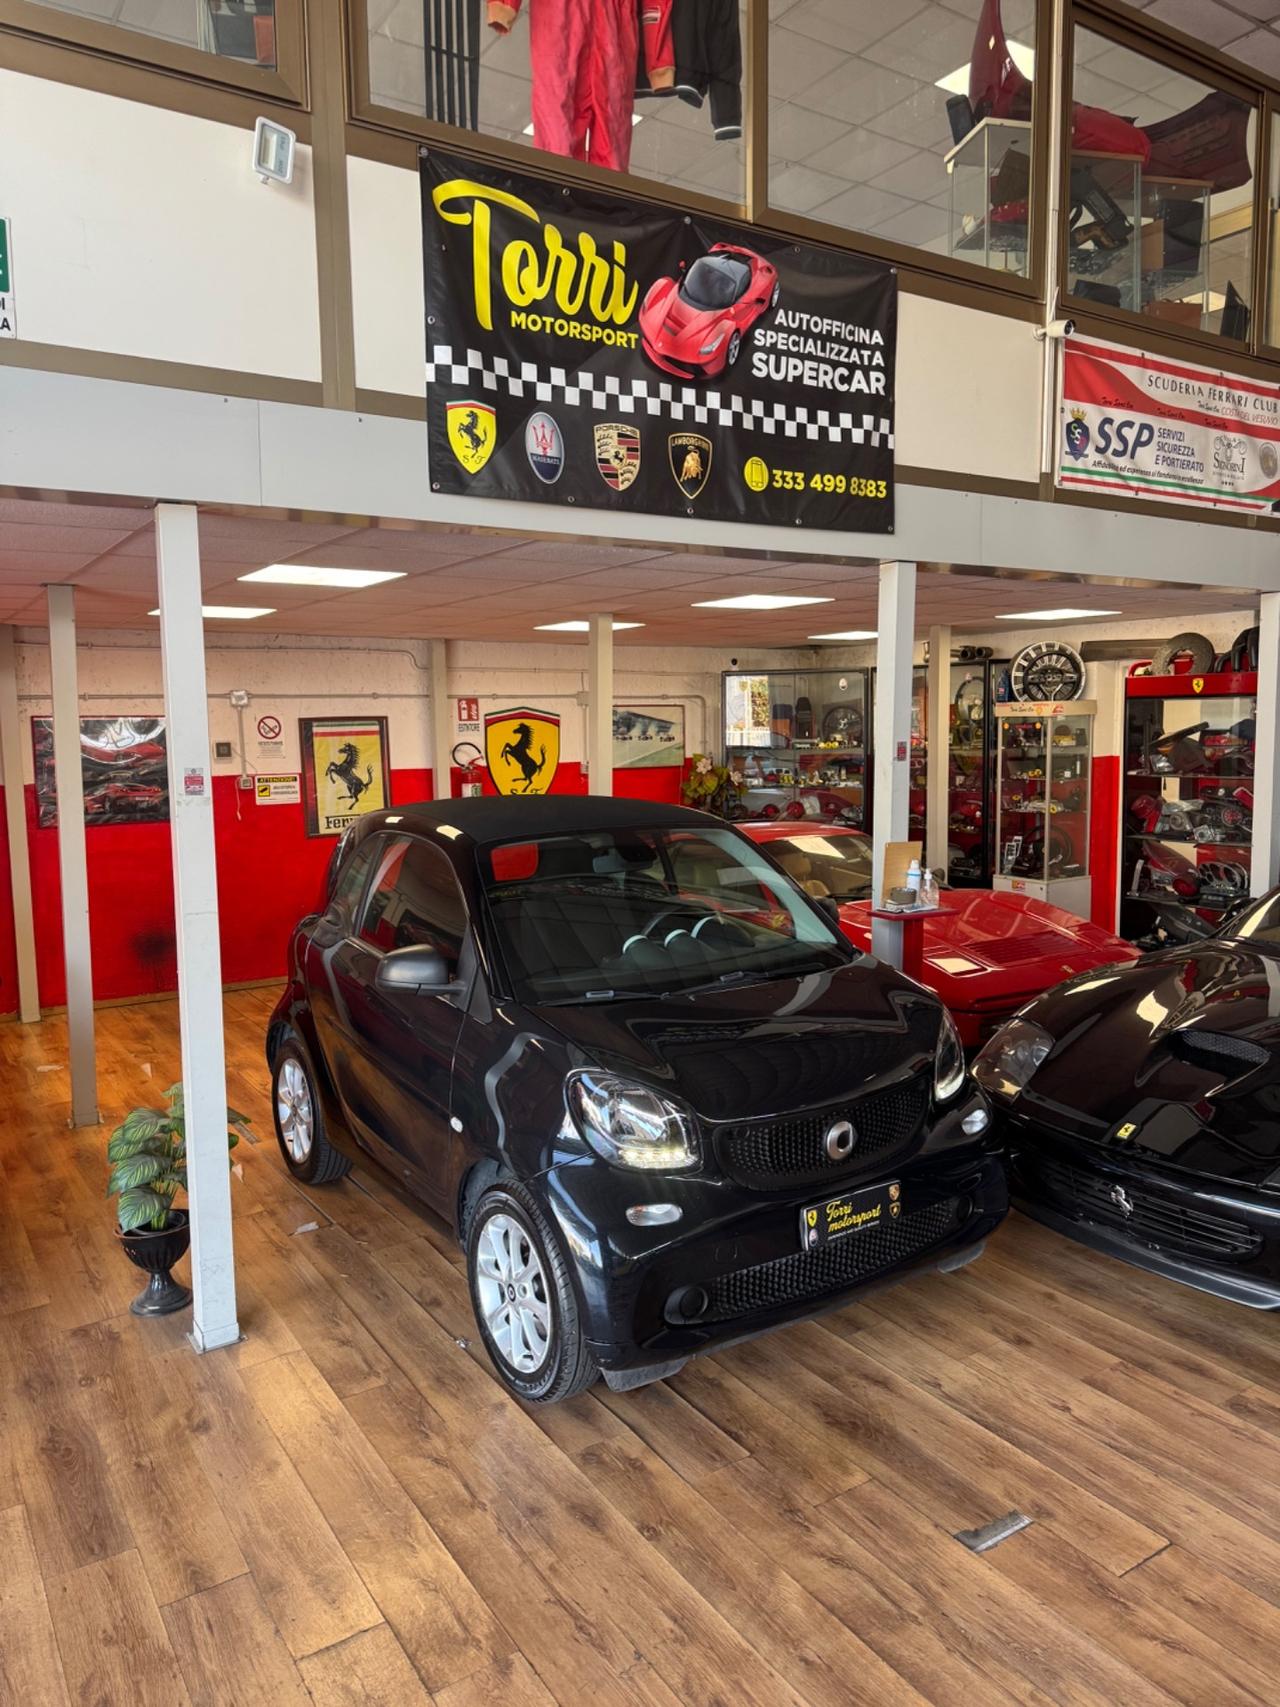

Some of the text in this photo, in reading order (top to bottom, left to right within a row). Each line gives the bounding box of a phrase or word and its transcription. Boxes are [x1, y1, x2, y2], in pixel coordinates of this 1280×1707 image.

[432, 178, 638, 331] Torri
[510, 309, 639, 351] MOTORSPORT
[773, 308, 884, 347] AUTOFFICINA
[753, 329, 885, 368] SPECIALIZZATA
[751, 352, 887, 396] SUPERCAR
[1147, 374, 1204, 398] SCUDERIA
[1207, 387, 1249, 407] FERRARI
[1252, 397, 1278, 414] CLUB
[595, 424, 640, 436] PORSCHE
[1095, 416, 1154, 460] SSP
[1156, 440, 1196, 457] SICUREZZA
[1157, 427, 1186, 442] SERVIZI
[1155, 455, 1205, 473] E PORTIERATO
[772, 469, 887, 499] 333 499 8383
[826, 1200, 852, 1221] Torri
